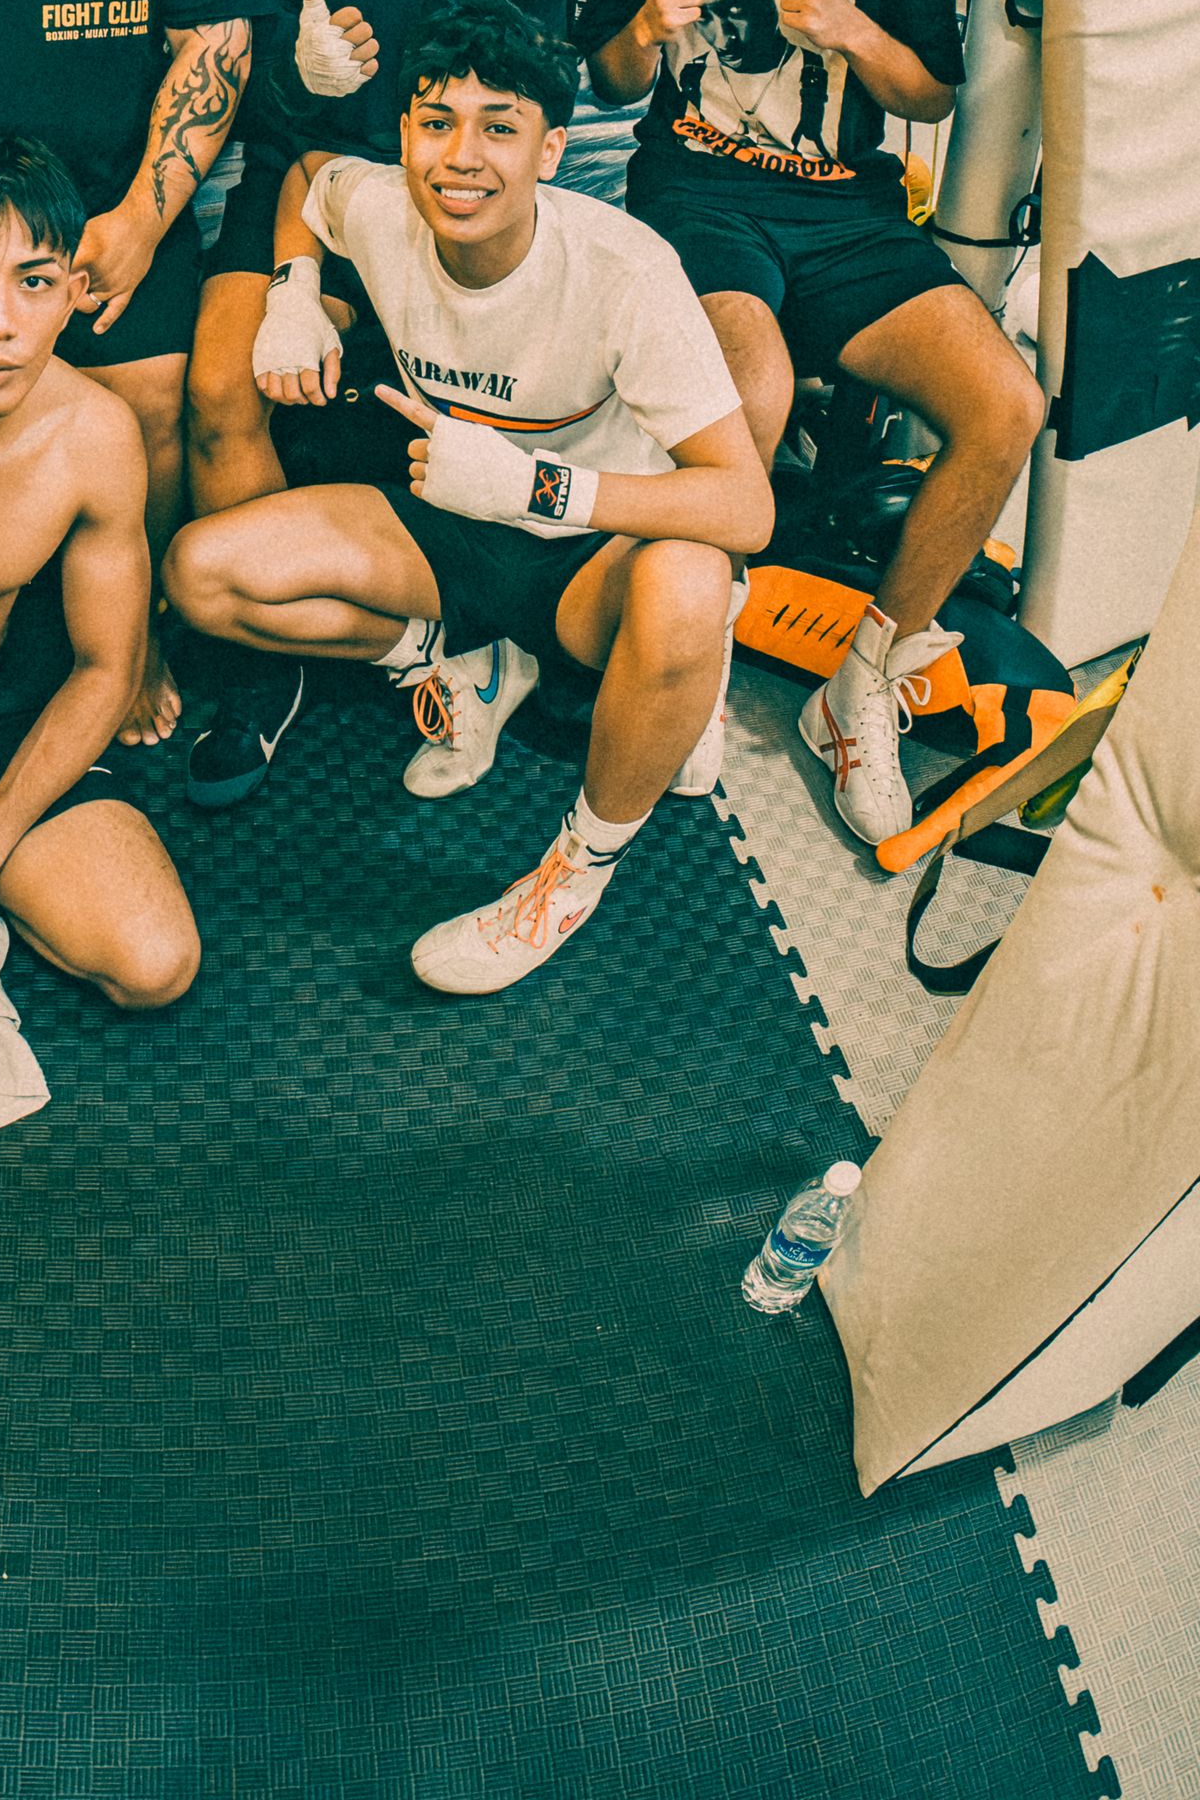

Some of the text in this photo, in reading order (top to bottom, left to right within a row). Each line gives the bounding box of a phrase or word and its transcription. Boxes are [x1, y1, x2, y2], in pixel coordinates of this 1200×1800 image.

[42, 0, 149, 29] FIGHT CLUB
[45, 24, 148, 42] BOXING MUAY THAI MMA
[398, 349, 518, 402] SARAWAK
[554, 468, 570, 517] STING
